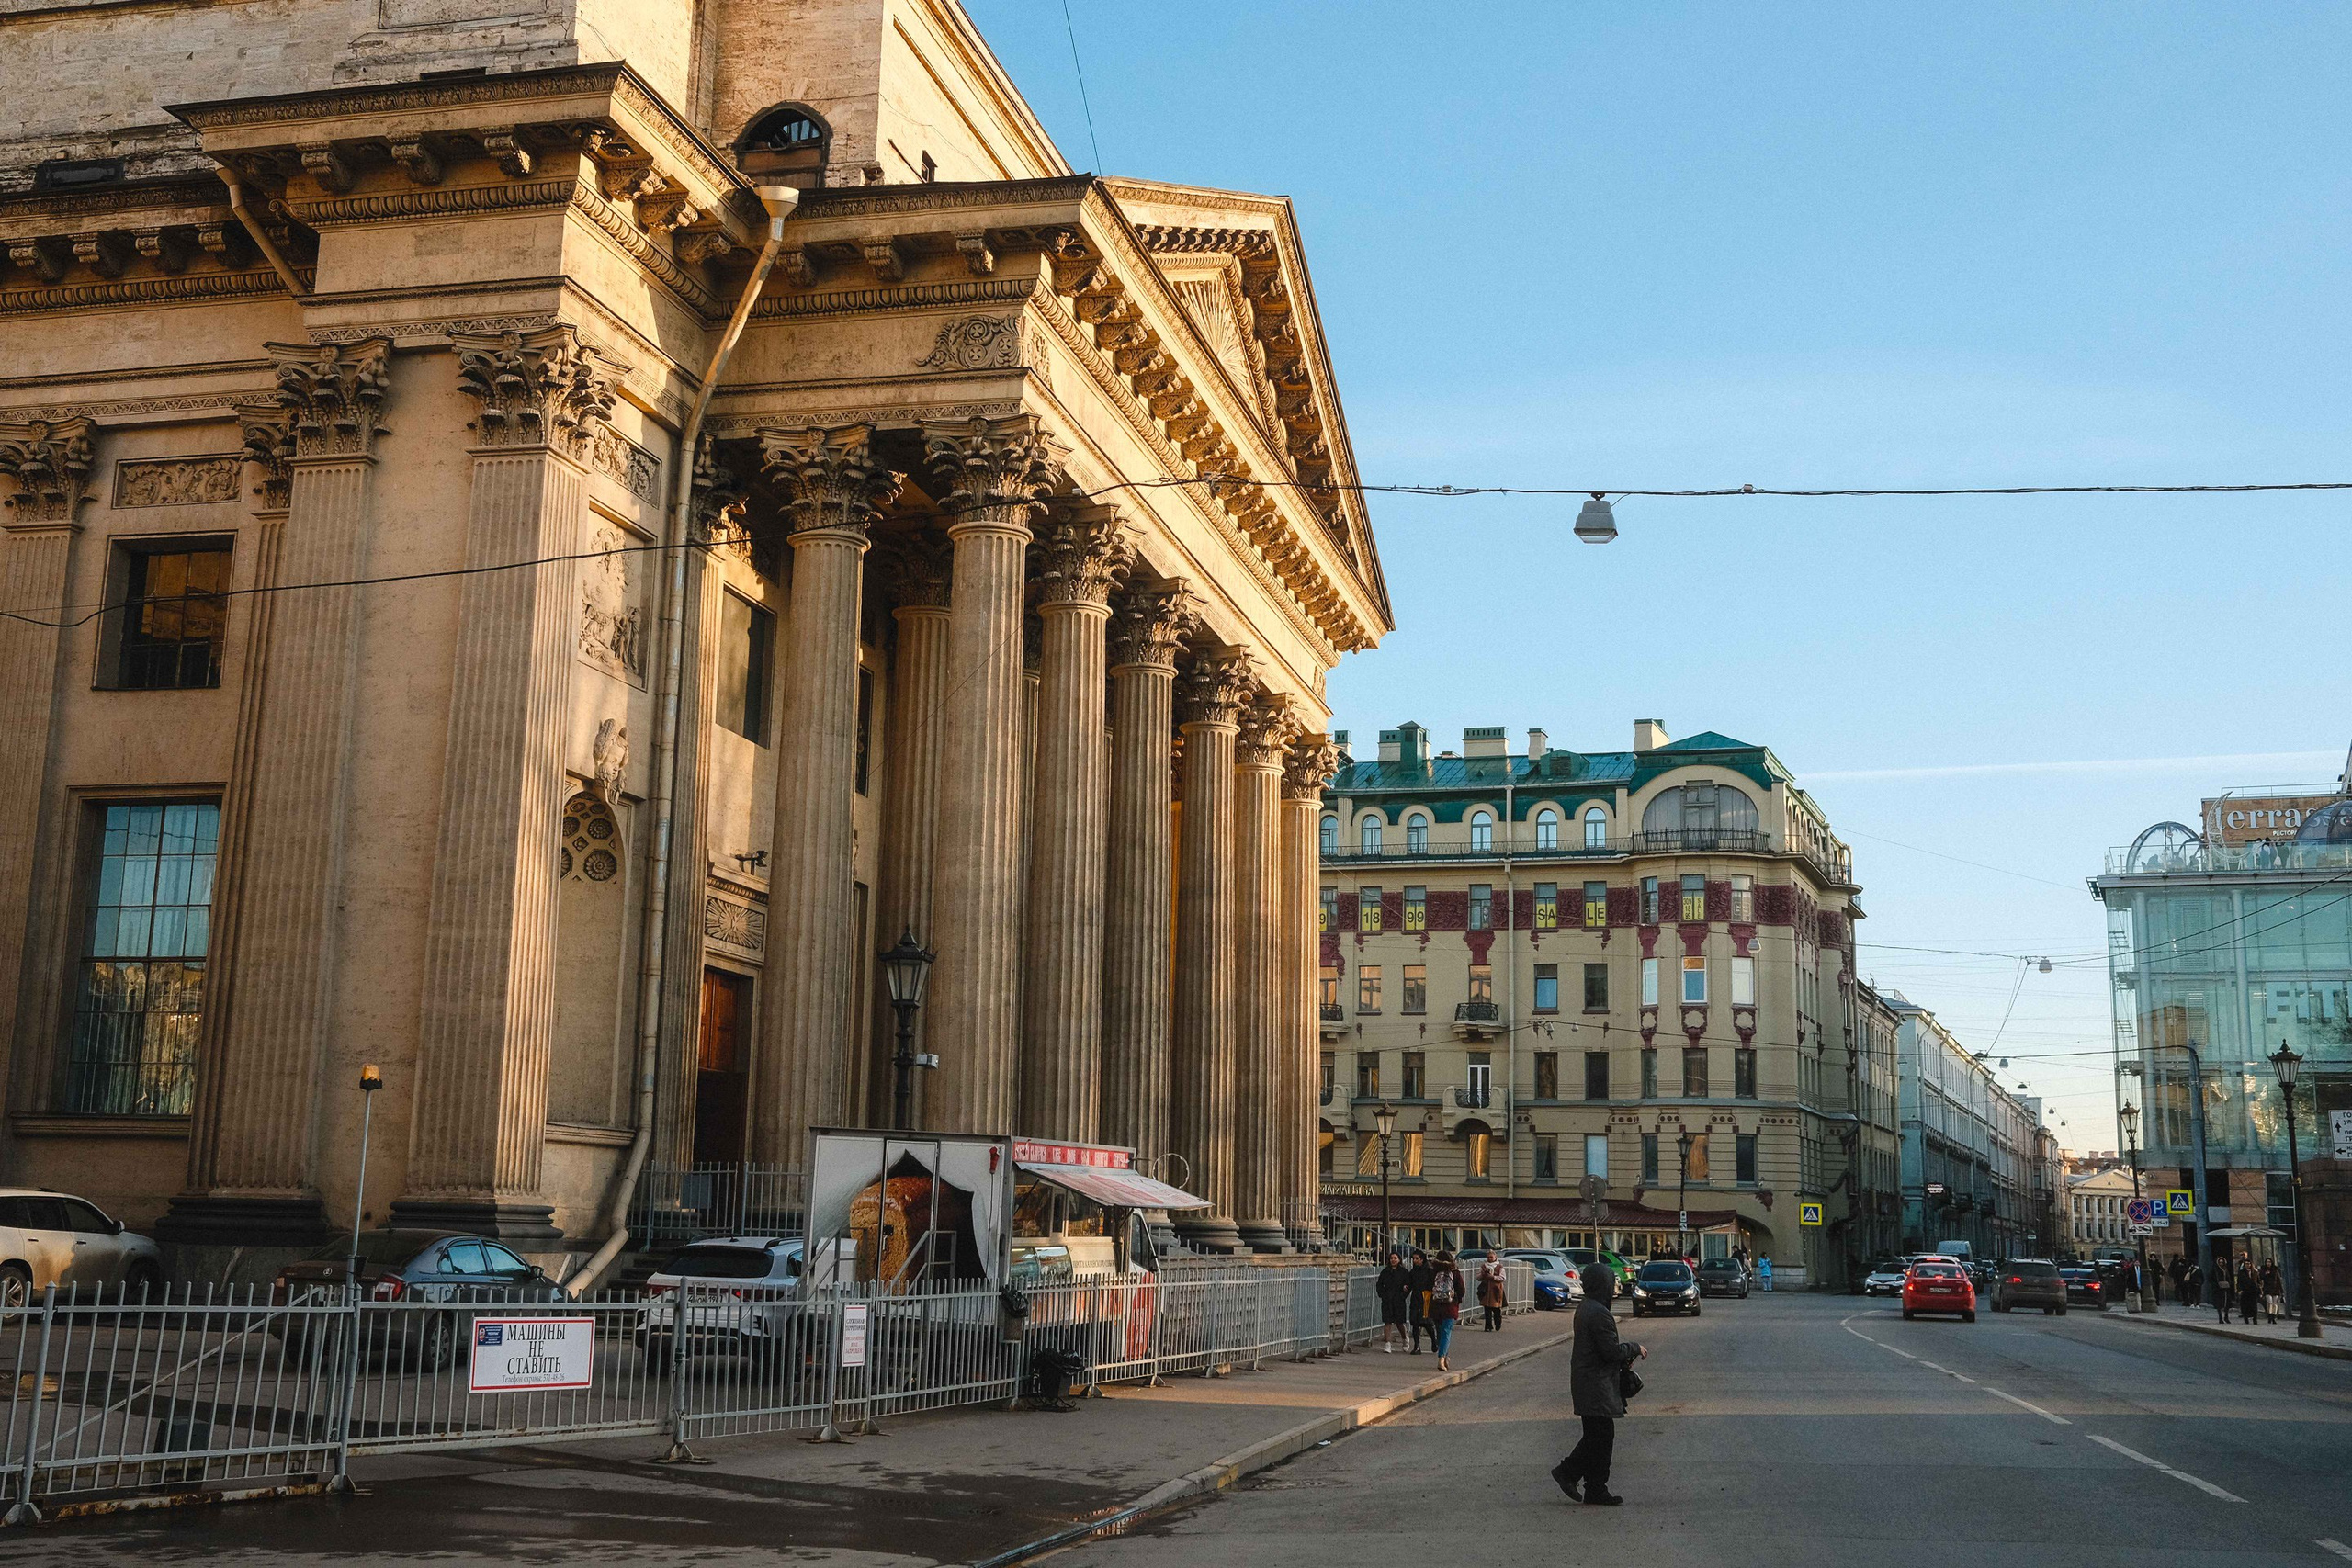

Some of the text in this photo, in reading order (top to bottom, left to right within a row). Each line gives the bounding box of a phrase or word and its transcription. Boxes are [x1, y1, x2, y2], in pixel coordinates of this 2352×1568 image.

[1363, 912, 1380, 924] 18
[1407, 911, 1424, 923] 99
[507, 1324, 566, 1341] МАШИНЫ
[528, 1341, 545, 1358] НЕ
[507, 1357, 561, 1375] СТАВИТЬ
